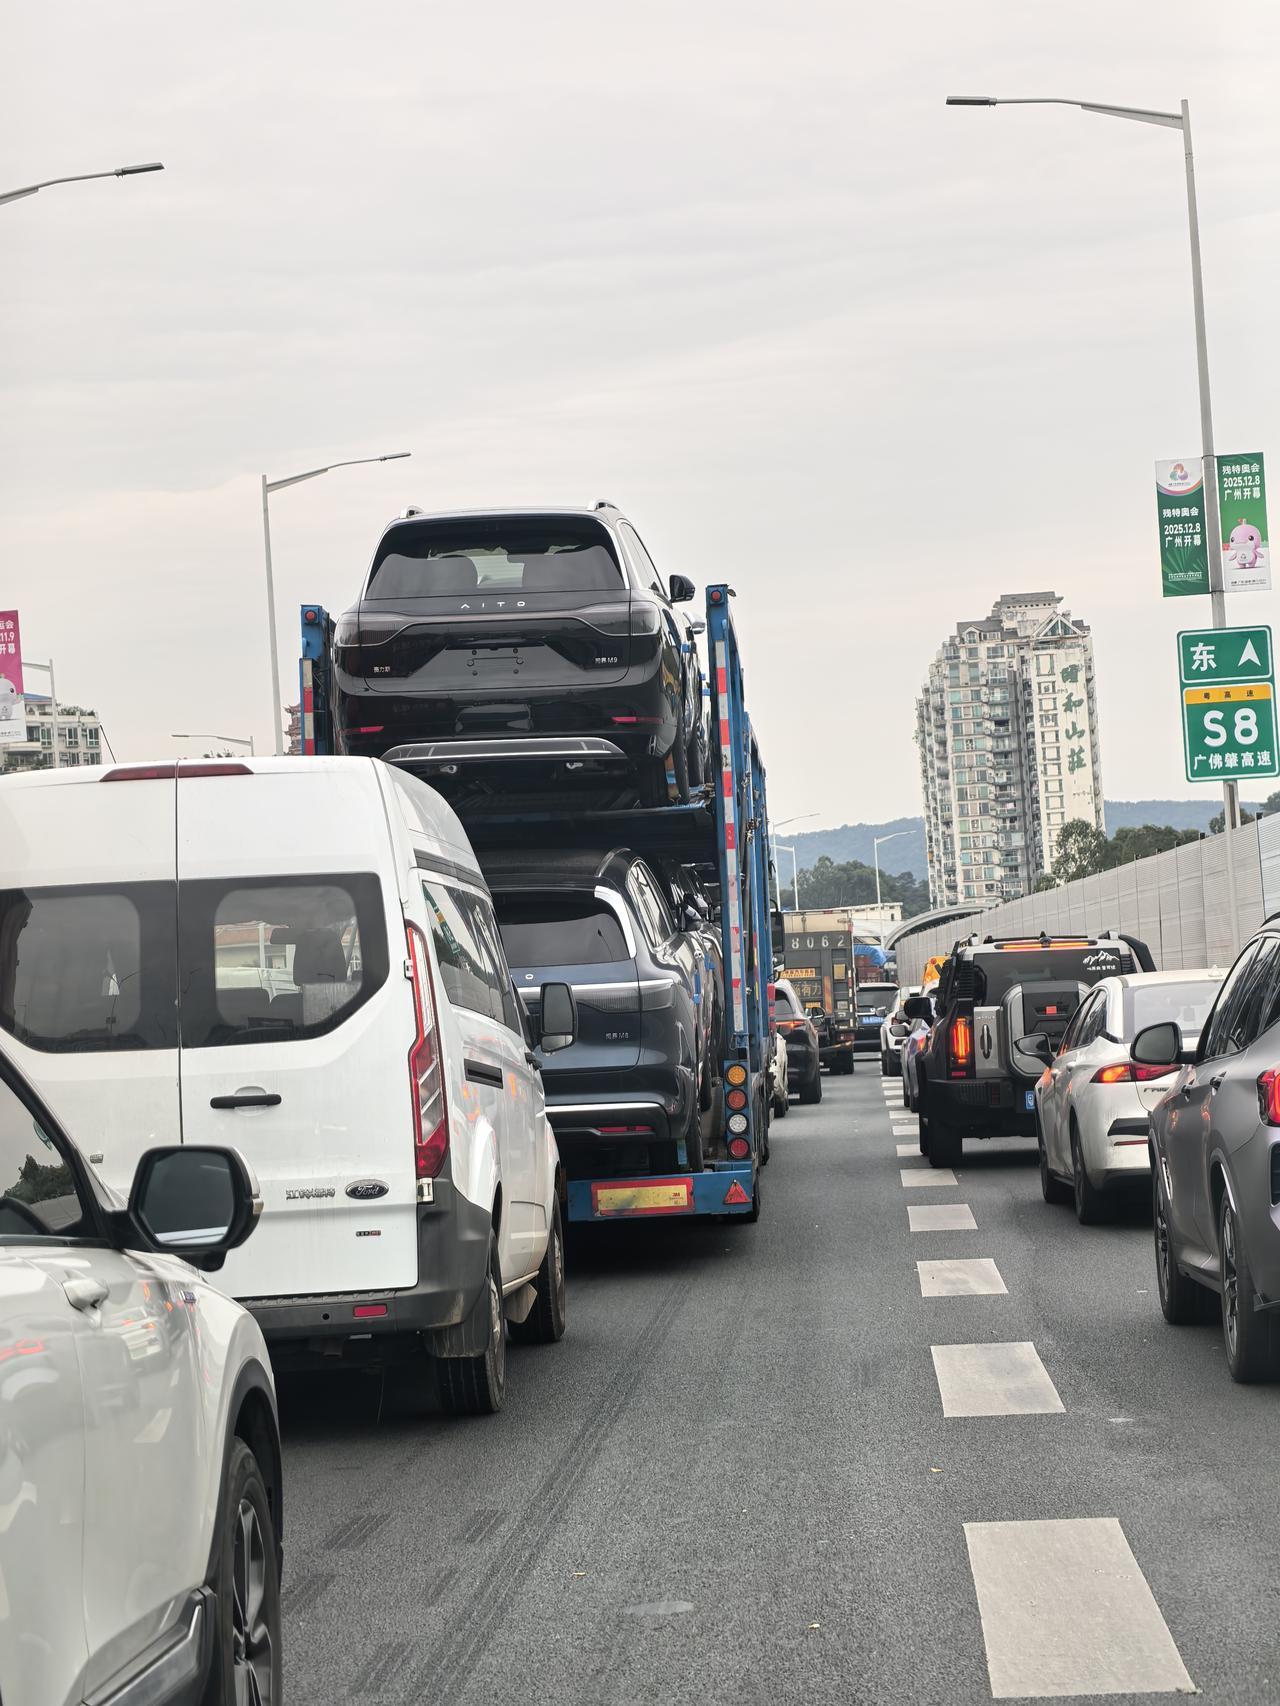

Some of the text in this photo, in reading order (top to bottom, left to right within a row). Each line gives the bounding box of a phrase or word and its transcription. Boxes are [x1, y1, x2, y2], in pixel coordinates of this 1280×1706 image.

[1222, 463, 1260, 475] 残特奥会
[1223, 475, 1260, 488] 2025.12.8
[1224, 487, 1261, 501] 广州开幕
[1163, 507, 1199, 518] 残特奥会
[1164, 522, 1201, 534] 2025.12.8
[1165, 535, 1202, 548] 广州开幕
[1190, 642, 1217, 671] 东
[1203, 707, 1259, 747] S8
[1193, 750, 1272, 770] 广佛肇高速
[791, 935, 844, 949] 8062
